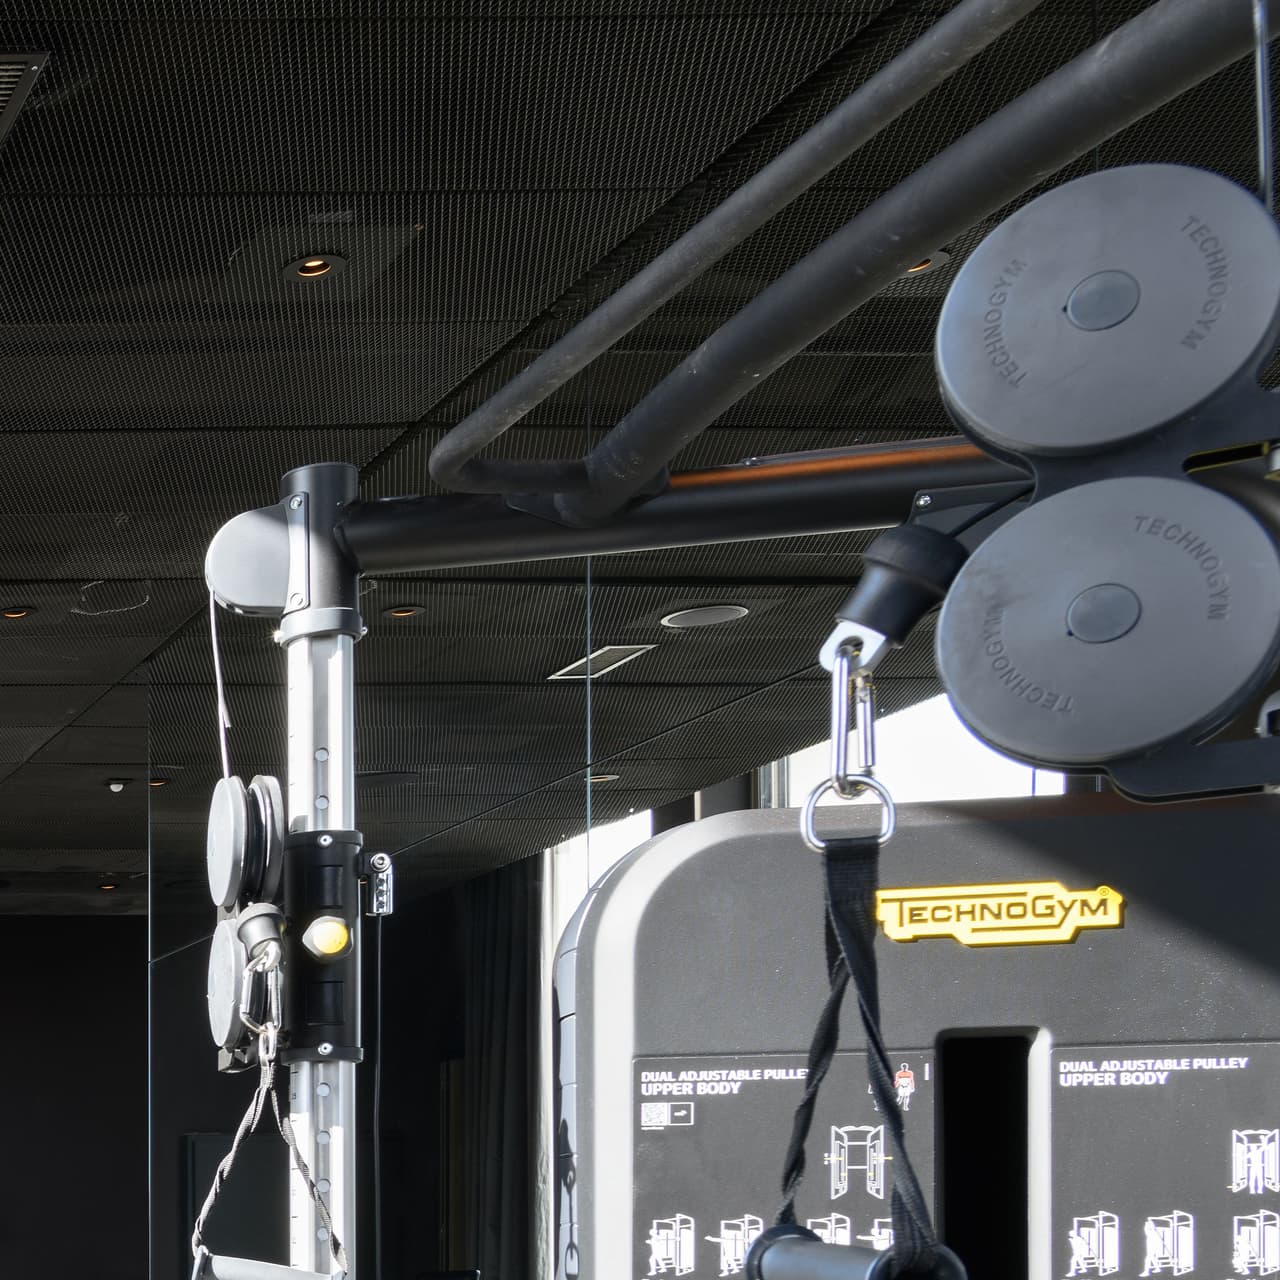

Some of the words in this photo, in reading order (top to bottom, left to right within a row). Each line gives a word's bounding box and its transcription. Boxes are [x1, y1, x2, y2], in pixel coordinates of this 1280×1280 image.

[1180, 215, 1229, 350] TECHNOGYM
[983, 259, 1027, 389] TECHNOGYM
[1135, 515, 1230, 620] TECHNOGYM
[1060, 1061, 1098, 1073] DUAL
[1100, 1059, 1191, 1071] ADJUSTABLE
[1193, 1057, 1249, 1070] PULLEY
[641, 1071, 676, 1082] DUAL
[678, 1069, 761, 1081] ADJUSTABLE
[764, 1068, 809, 1080] PULLE
[1060, 1073, 1117, 1086] UPPER
[1120, 1072, 1170, 1085] BODY
[641, 1083, 695, 1096] UPPER
[697, 1082, 742, 1095] BODY
